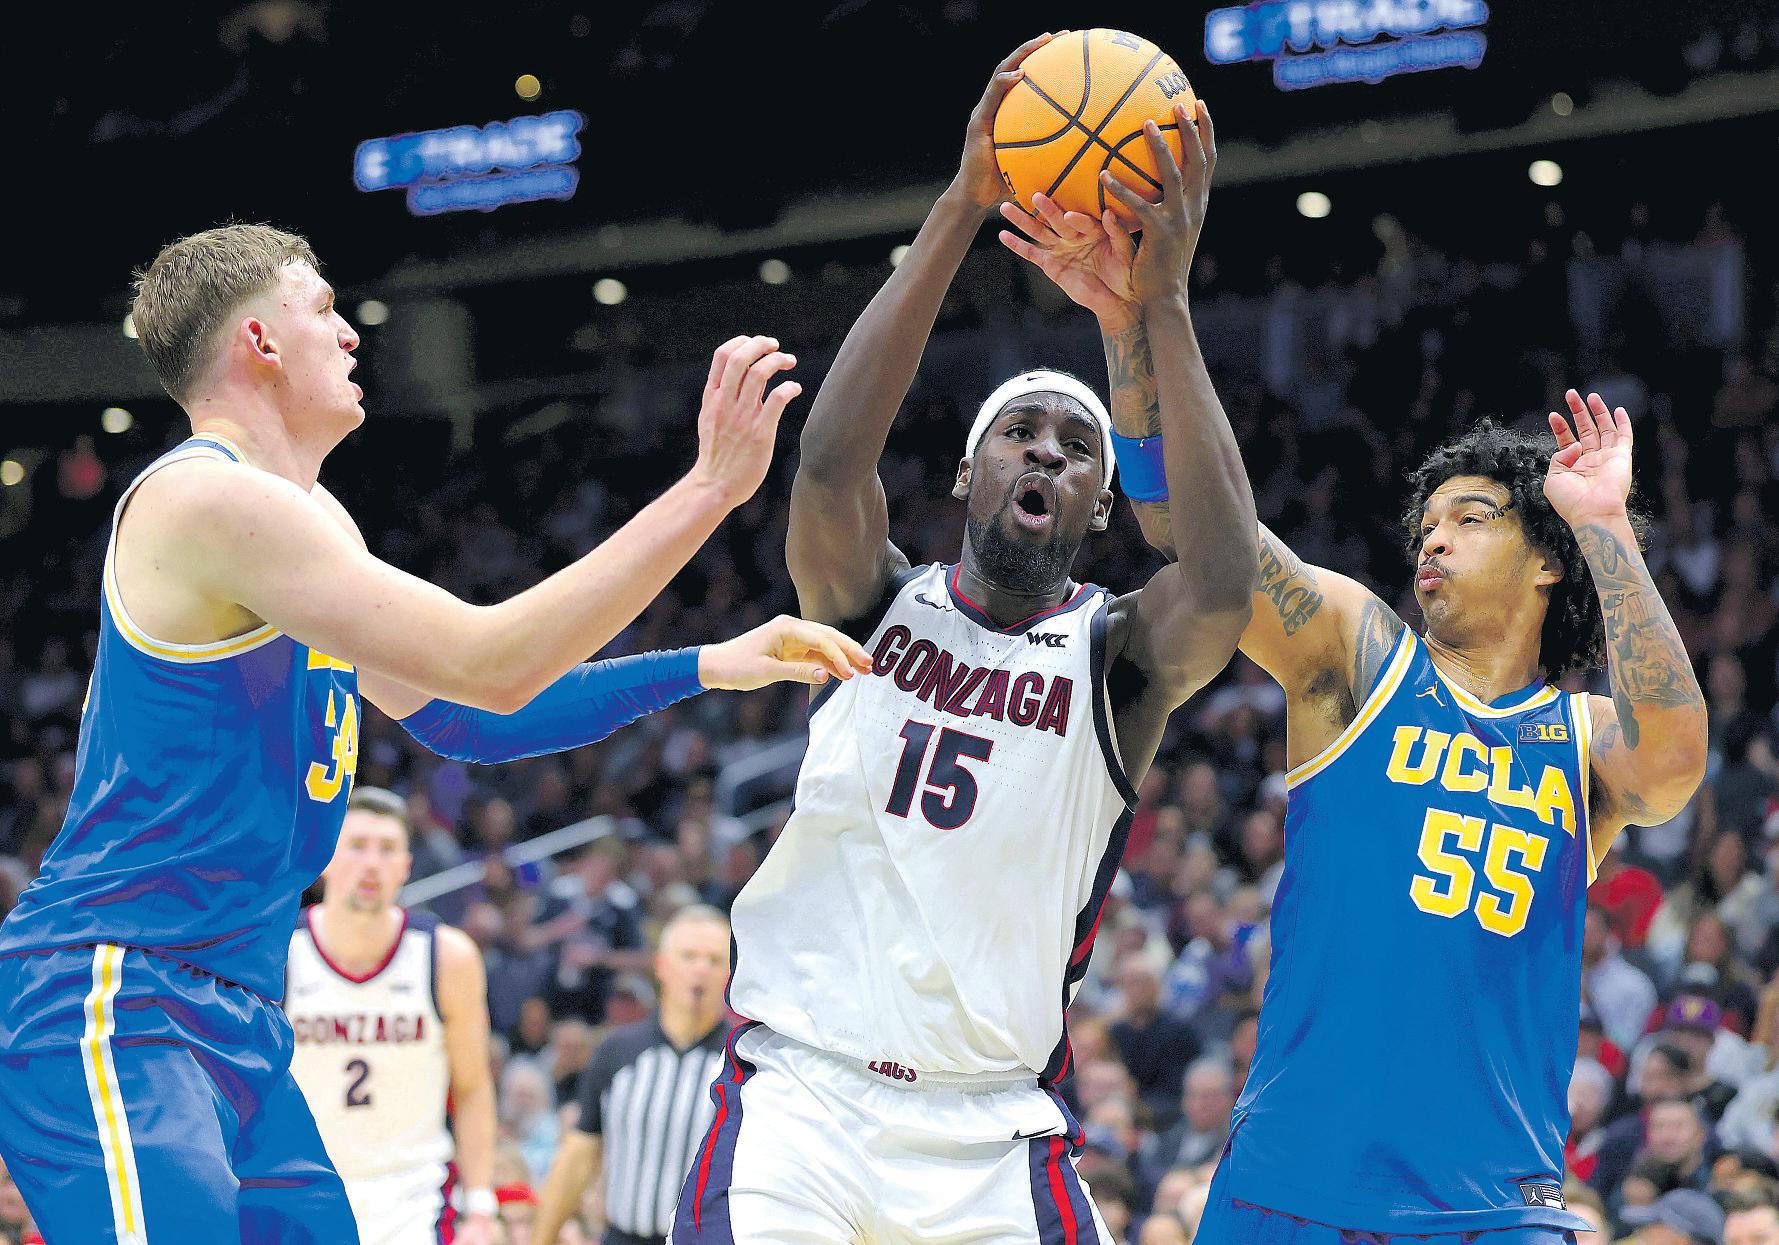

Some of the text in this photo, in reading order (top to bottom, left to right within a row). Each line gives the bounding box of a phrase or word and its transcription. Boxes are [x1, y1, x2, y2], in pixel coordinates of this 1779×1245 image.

[871, 624, 1074, 738] GONZAGA
[1026, 632, 1069, 648] WCC
[305, 688, 359, 803] 34
[885, 719, 994, 831] 15
[1386, 725, 1577, 839] UCLA
[1409, 807, 1549, 938] 55
[294, 1013, 429, 1045] GONZAGA
[345, 1058, 371, 1108] 2
